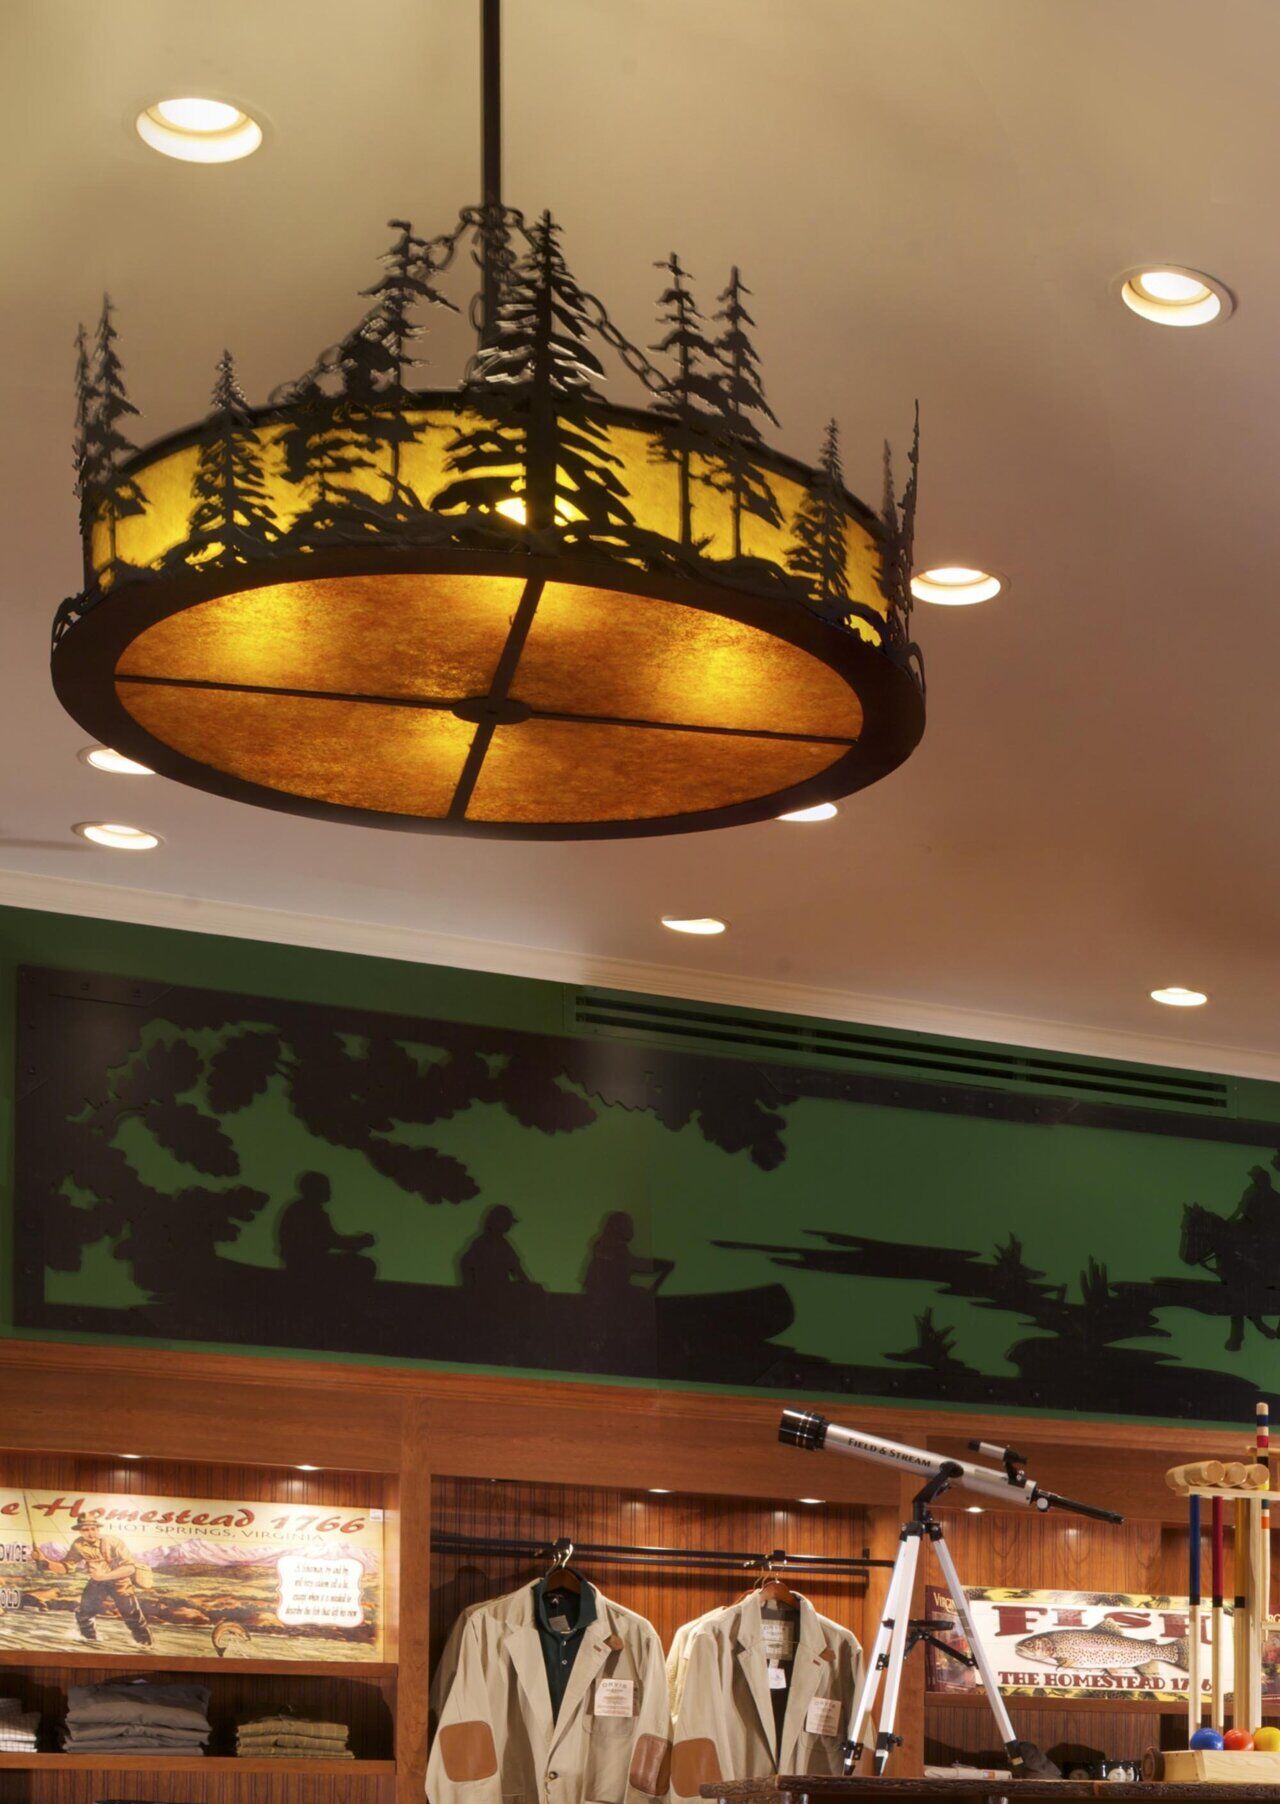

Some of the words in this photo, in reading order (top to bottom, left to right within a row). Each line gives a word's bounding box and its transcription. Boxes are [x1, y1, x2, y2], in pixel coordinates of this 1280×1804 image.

[848, 1437, 877, 1453] FIELD
[879, 1447, 887, 1456] &
[890, 1449, 931, 1468] STREAM
[32, 1496, 257, 1531] Homestead
[270, 1514, 366, 1535] 1766
[109, 1524, 146, 1533] HOT
[155, 1525, 236, 1538] SPRINGS,
[991, 1604, 1213, 1645] FISH
[999, 1671, 1042, 1685] THE
[1045, 1672, 1166, 1690] HOMESTEAD
[1170, 1677, 1213, 1692] 176
